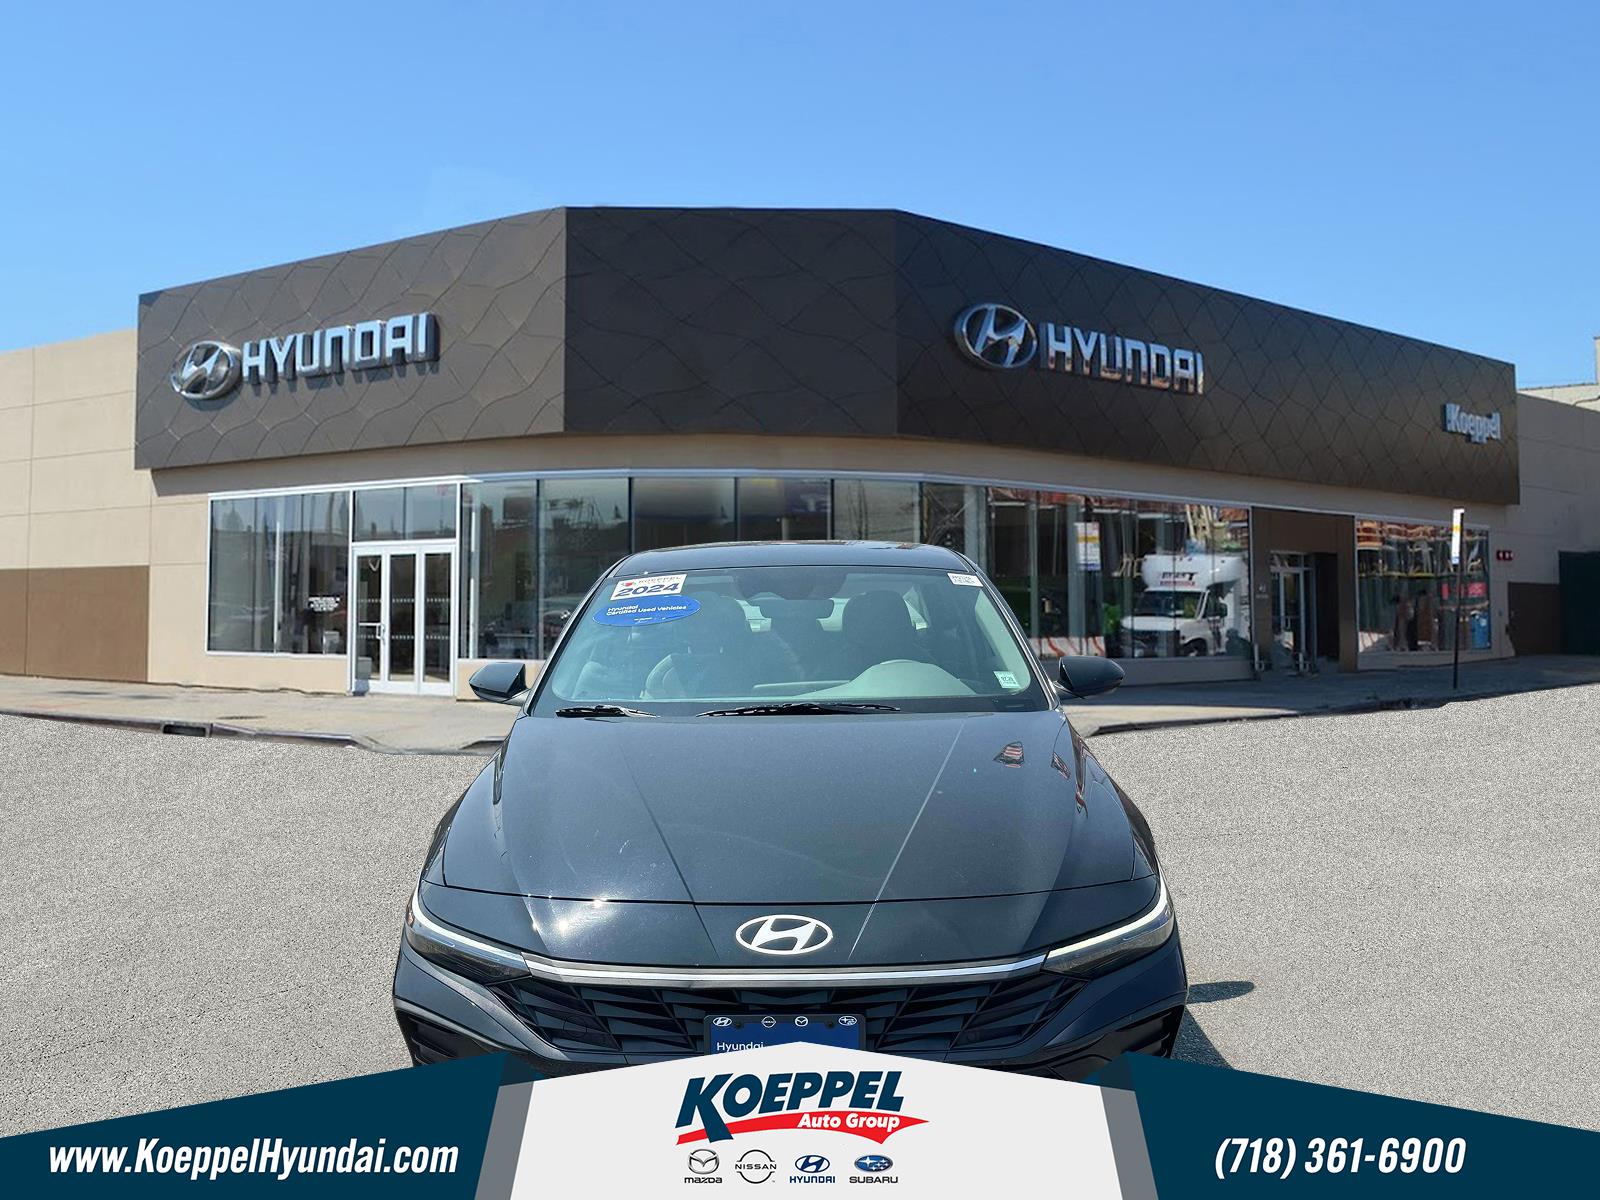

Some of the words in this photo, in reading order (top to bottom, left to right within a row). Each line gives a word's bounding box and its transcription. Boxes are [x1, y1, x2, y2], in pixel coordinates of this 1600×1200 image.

[242, 312, 433, 383] HYUNDAI
[1047, 322, 1205, 394] HYUNDAI
[1445, 402, 1501, 444] Koeppel
[615, 582, 680, 598] 2024
[607, 604, 639, 612] Hyundai
[716, 1041, 764, 1052] Hyundai
